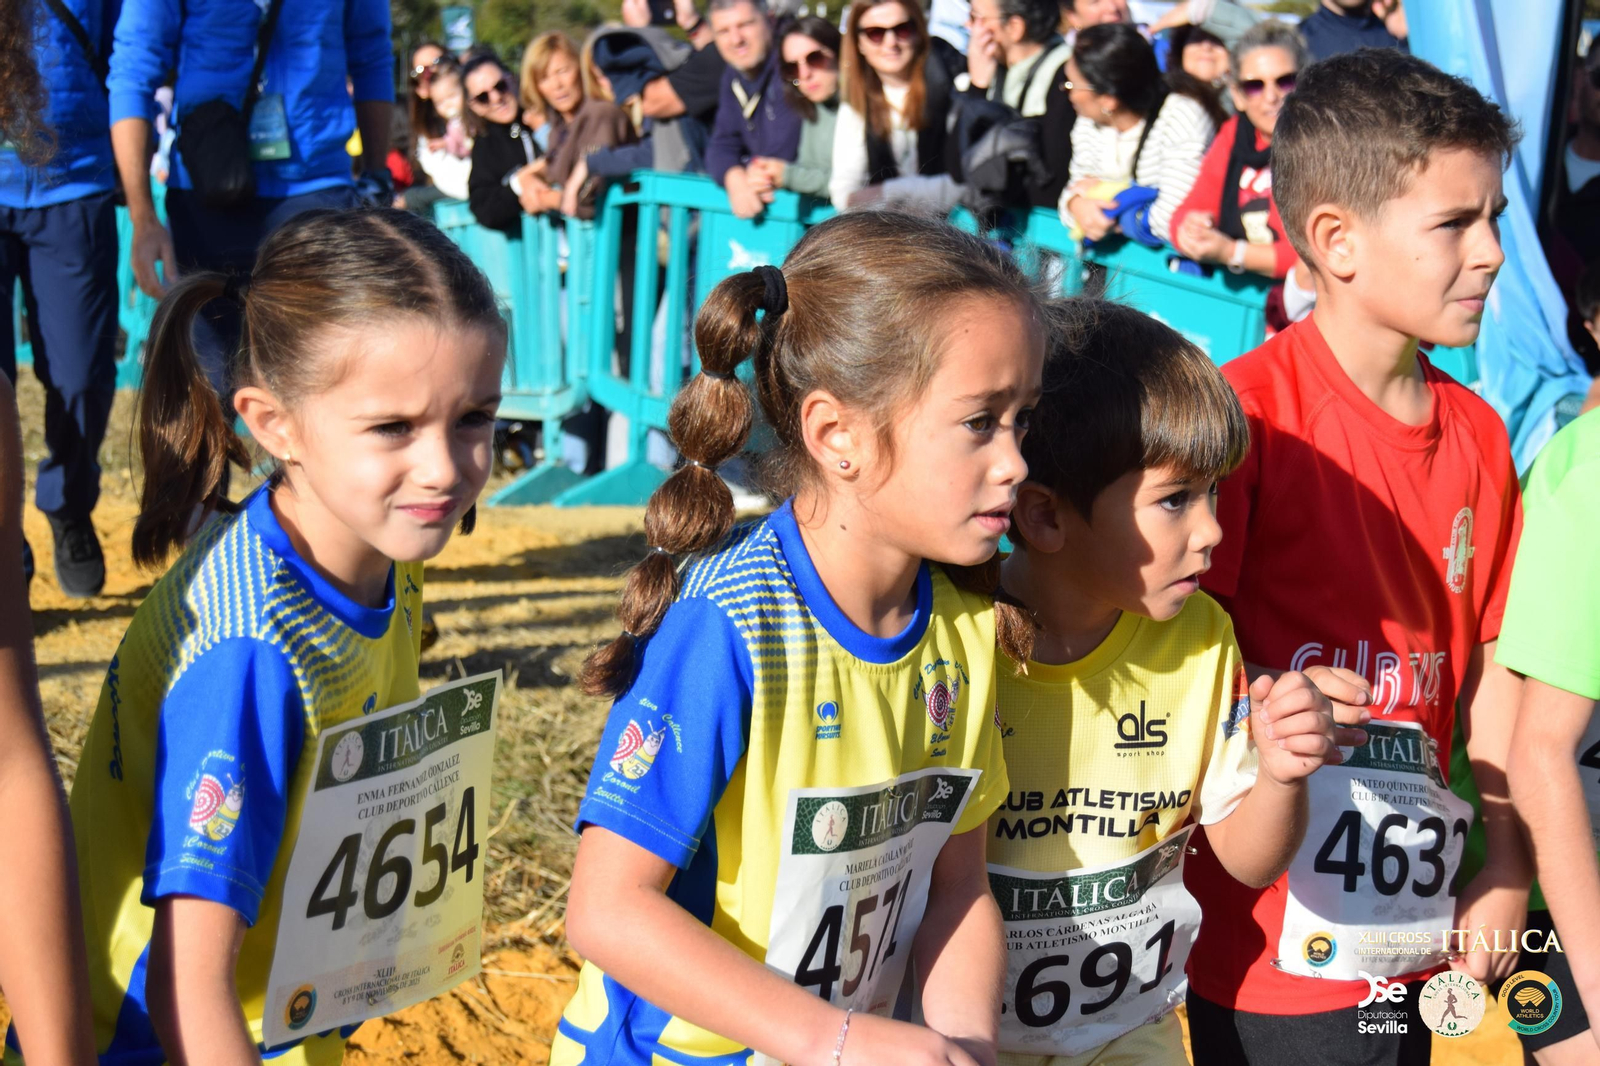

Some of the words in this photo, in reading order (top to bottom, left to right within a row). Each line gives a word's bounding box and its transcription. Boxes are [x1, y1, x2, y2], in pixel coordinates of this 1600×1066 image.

[378, 705, 449, 763] ITÁLICA
[460, 722, 481, 736] Sevilla
[1114, 700, 1168, 749] als
[357, 789, 386, 805] ENMA
[428, 753, 460, 779] GONZALEZ
[358, 803, 385, 820] CLUB
[428, 770, 460, 796] CALLENCE
[1352, 778, 1385, 789] MATEO
[1352, 791, 1377, 801] CLUB
[1378, 793, 1390, 803] DE
[860, 790, 919, 837] ITÁLICA
[921, 810, 943, 820] Sevilla
[1050, 788, 1192, 811] ATLETISMO
[306, 786, 479, 931] 4654
[845, 856, 877, 875] MARIELA
[840, 878, 861, 892] CLUB
[862, 865, 895, 887] DEPORTIVO
[1011, 870, 1139, 912] ITÁLICA
[1011, 908, 1081, 920] INTERNATIONAL
[1083, 903, 1110, 914] CROSS
[1046, 916, 1111, 936] CÁRDENAS
[794, 869, 913, 1002] 4571
[1026, 931, 1097, 950] ATLETISMO
[1100, 914, 1159, 936] MONTILLA
[1002, 919, 1175, 1027] 691
